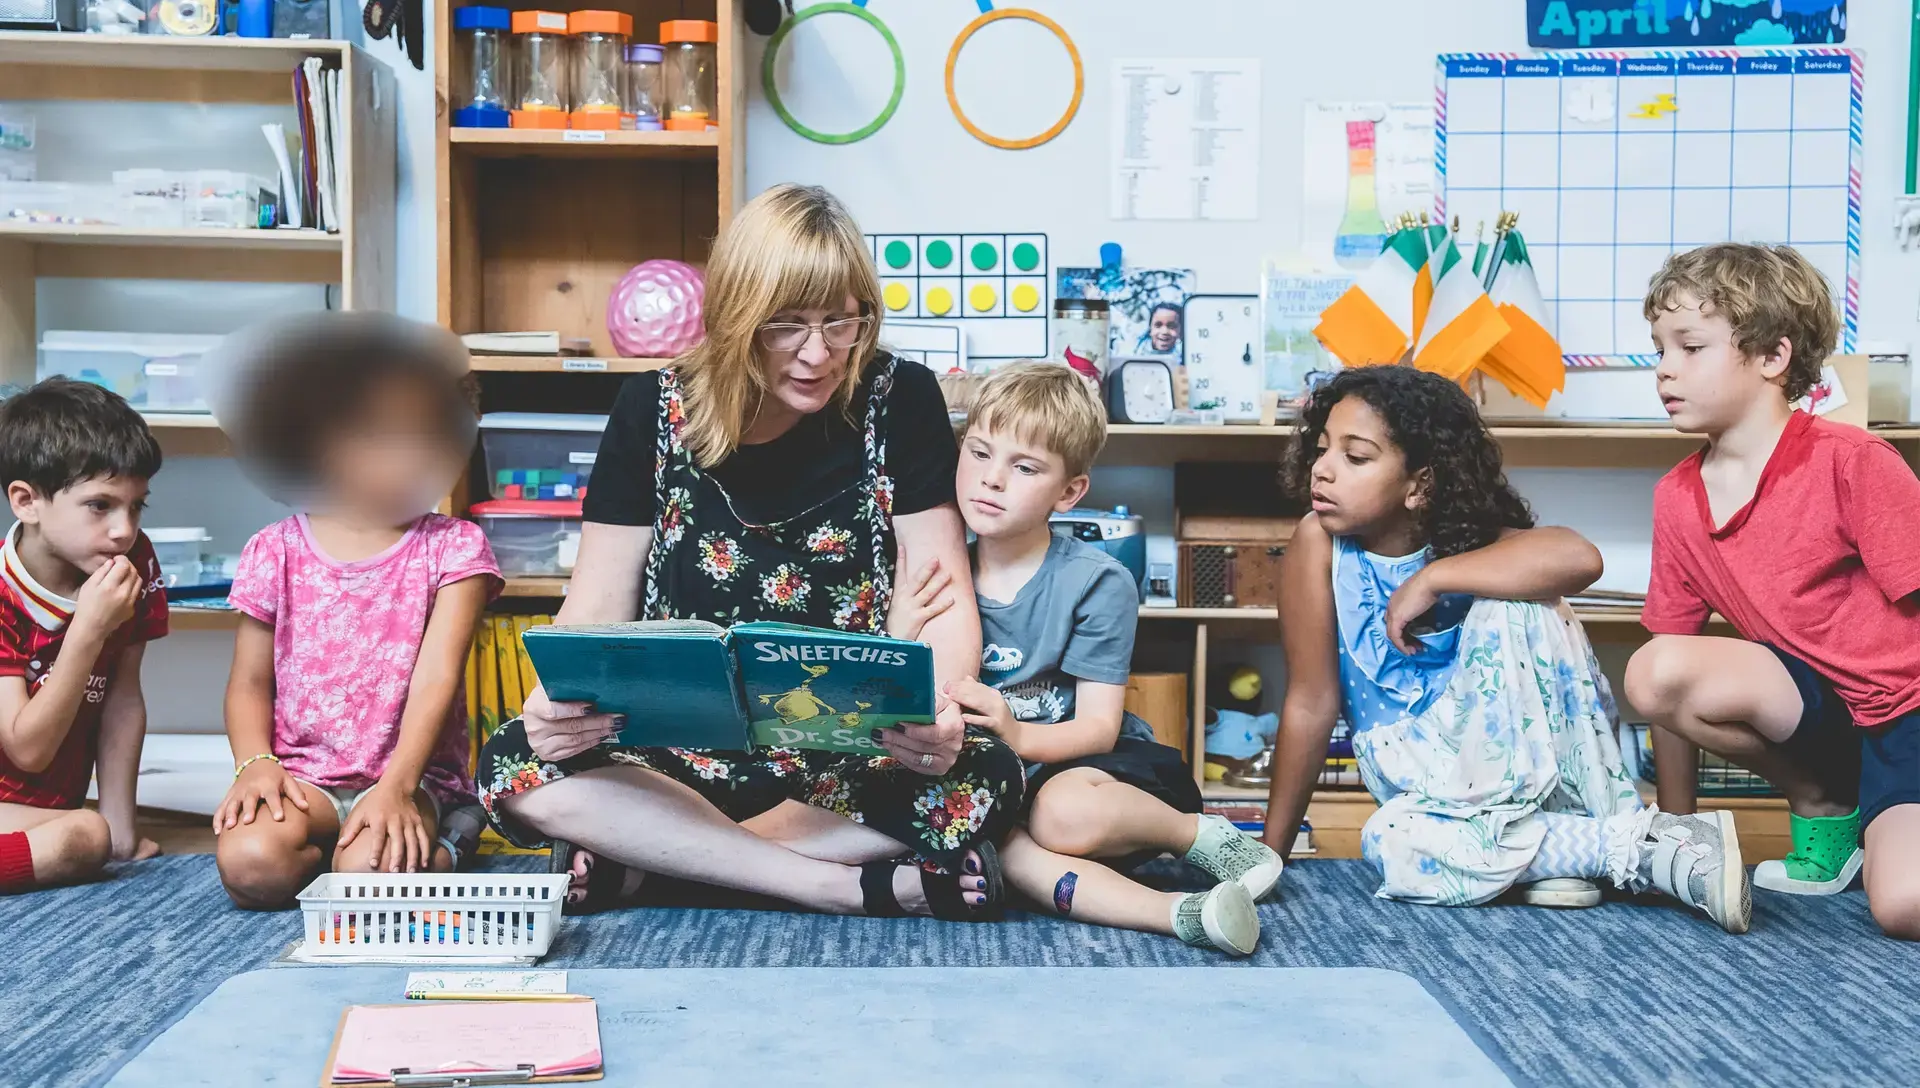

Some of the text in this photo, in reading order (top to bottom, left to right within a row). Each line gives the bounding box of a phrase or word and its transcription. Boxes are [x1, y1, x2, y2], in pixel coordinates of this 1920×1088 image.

[1538, 0, 1670, 47] April
[1459, 64, 1489, 74] Sunday
[1516, 64, 1549, 74] Monday
[1572, 63, 1606, 73] Tuesday
[1627, 63, 1668, 73] Wednesday
[1687, 62, 1724, 72] Thursday
[1750, 61, 1778, 71] Friday
[1804, 61, 1842, 70] Saturday
[1243, 306, 1251, 316] 0
[1217, 311, 1224, 322] 5
[1198, 328, 1209, 338] 10
[1191, 353, 1202, 363] 15
[1196, 378, 1209, 389] 20
[1240, 401, 1253, 412] 30
[754, 641, 908, 666] SNEETCHES
[769, 727, 825, 745] Dr.
